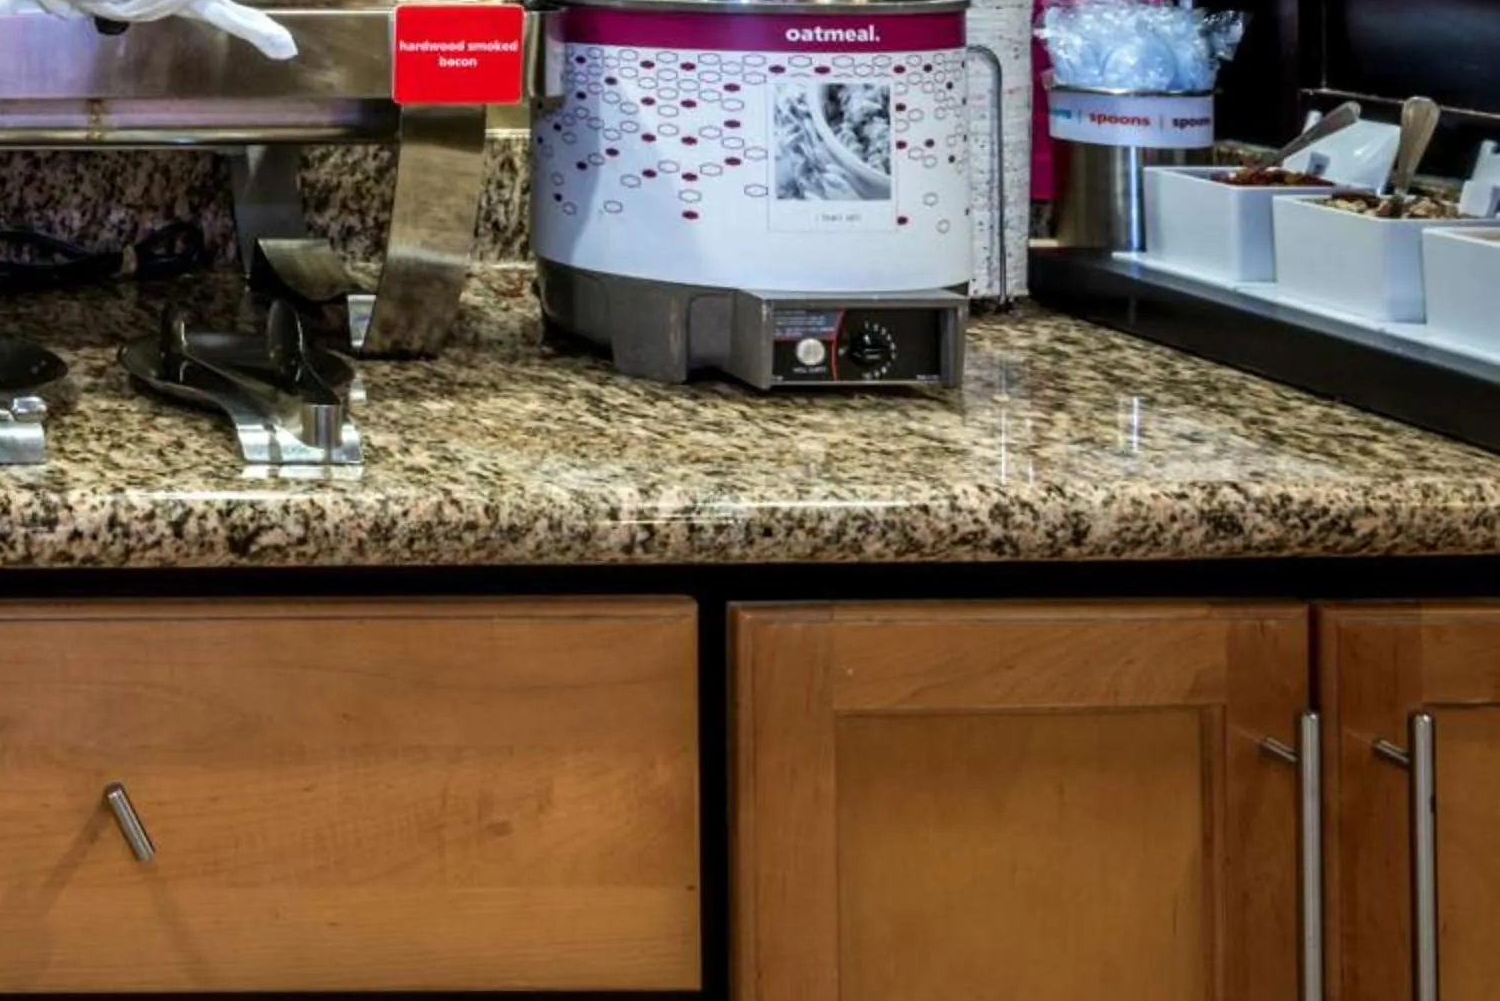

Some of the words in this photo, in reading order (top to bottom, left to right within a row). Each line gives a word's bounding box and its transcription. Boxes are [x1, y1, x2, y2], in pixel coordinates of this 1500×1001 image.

[785, 24, 881, 42] oatmeal.
[438, 55, 478, 68] bacon
[1088, 111, 1151, 127] spoons
